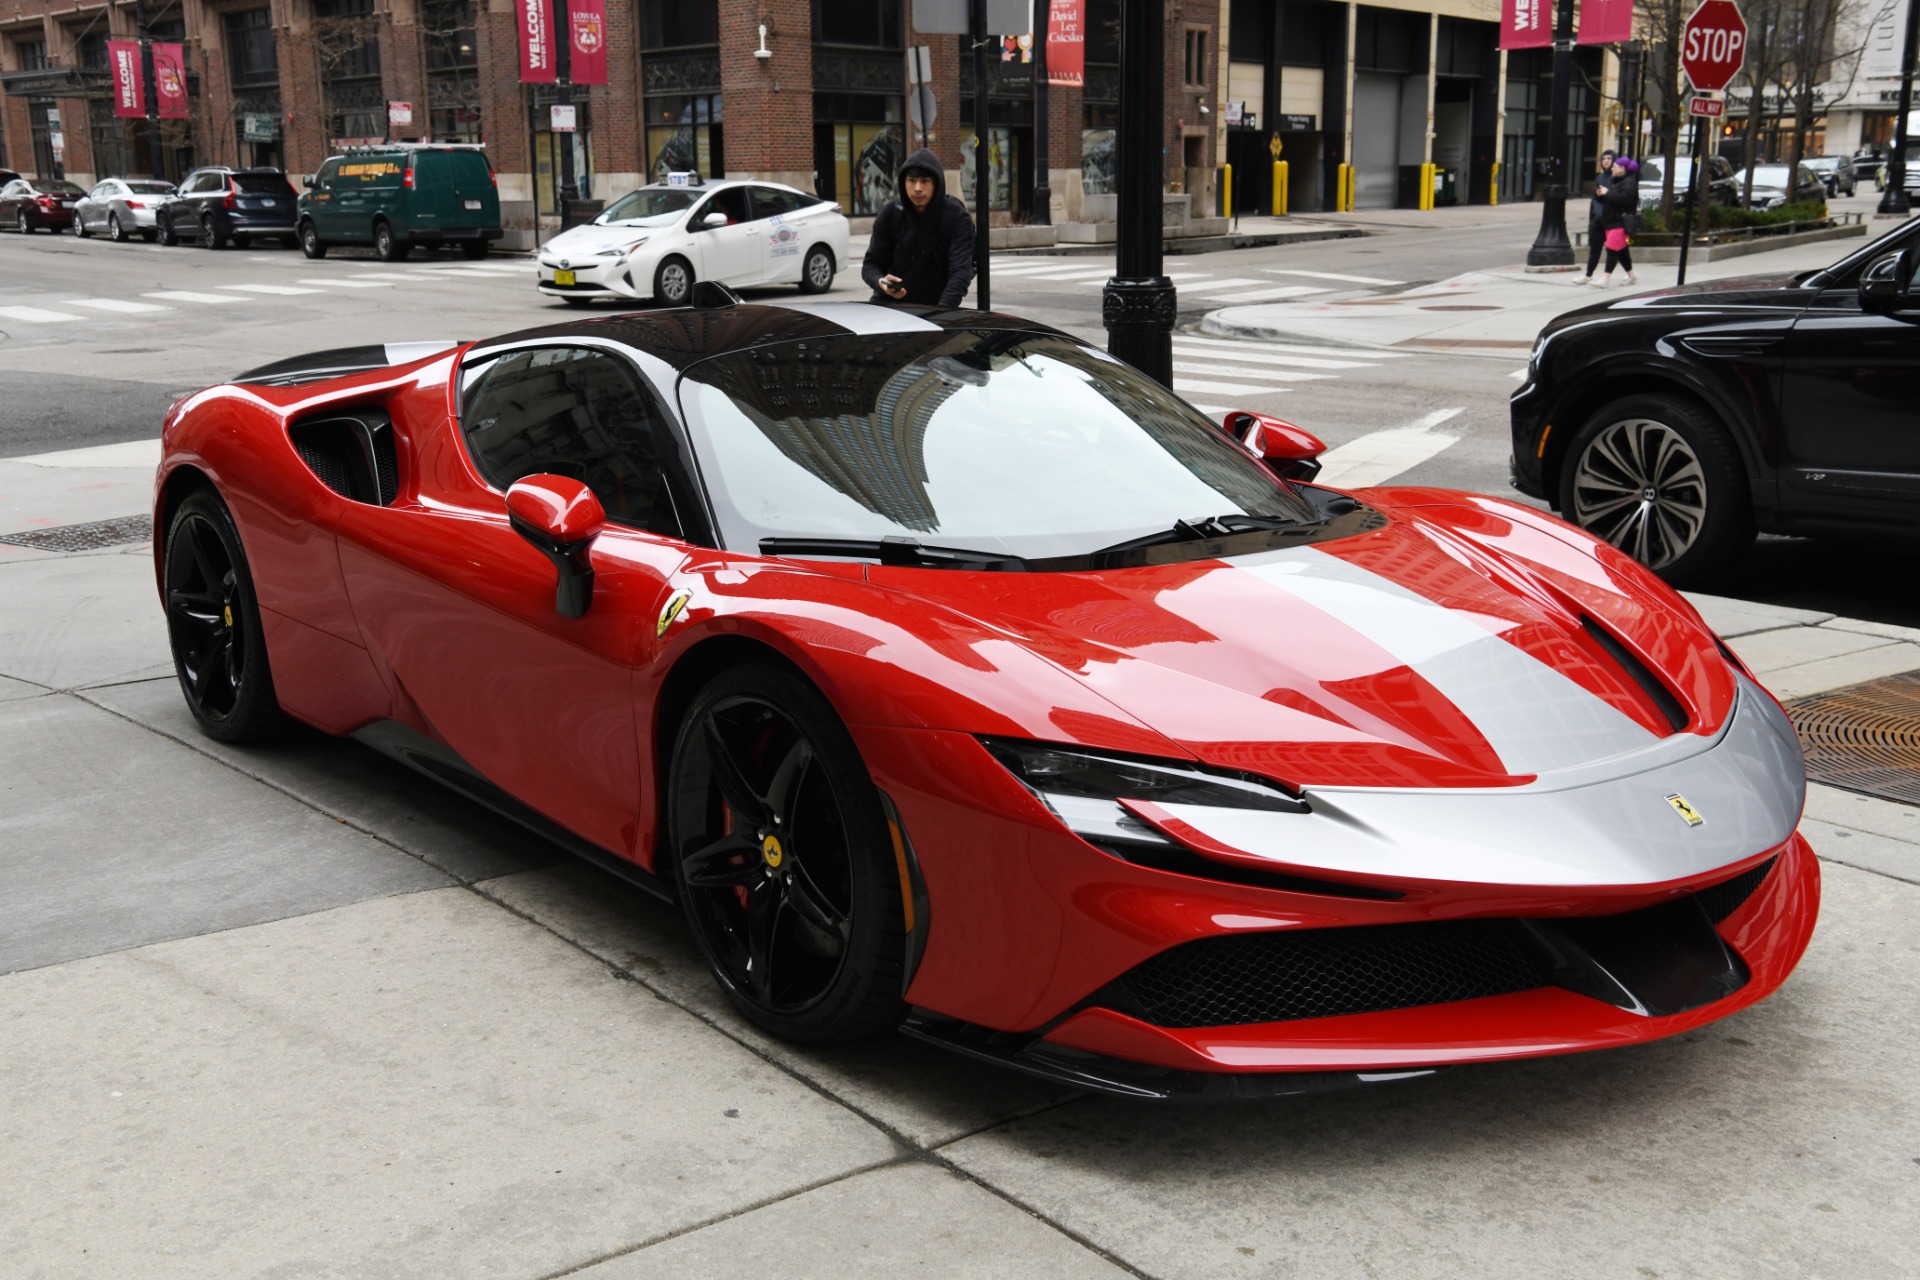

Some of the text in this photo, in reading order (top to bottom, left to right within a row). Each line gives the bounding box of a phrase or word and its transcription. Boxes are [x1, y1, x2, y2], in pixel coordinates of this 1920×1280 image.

[573, 12, 600, 20] LOYOLA
[1051, 10, 1077, 21] David
[1061, 21, 1077, 31] Lee
[1049, 31, 1084, 43] Csicsko
[1685, 27, 1742, 63] STOP
[116, 50, 132, 108] WELCOME
[1048, 71, 1083, 82] LUMA
[1693, 101, 1721, 114] ALL WAY
[669, 175, 687, 185] 1787
